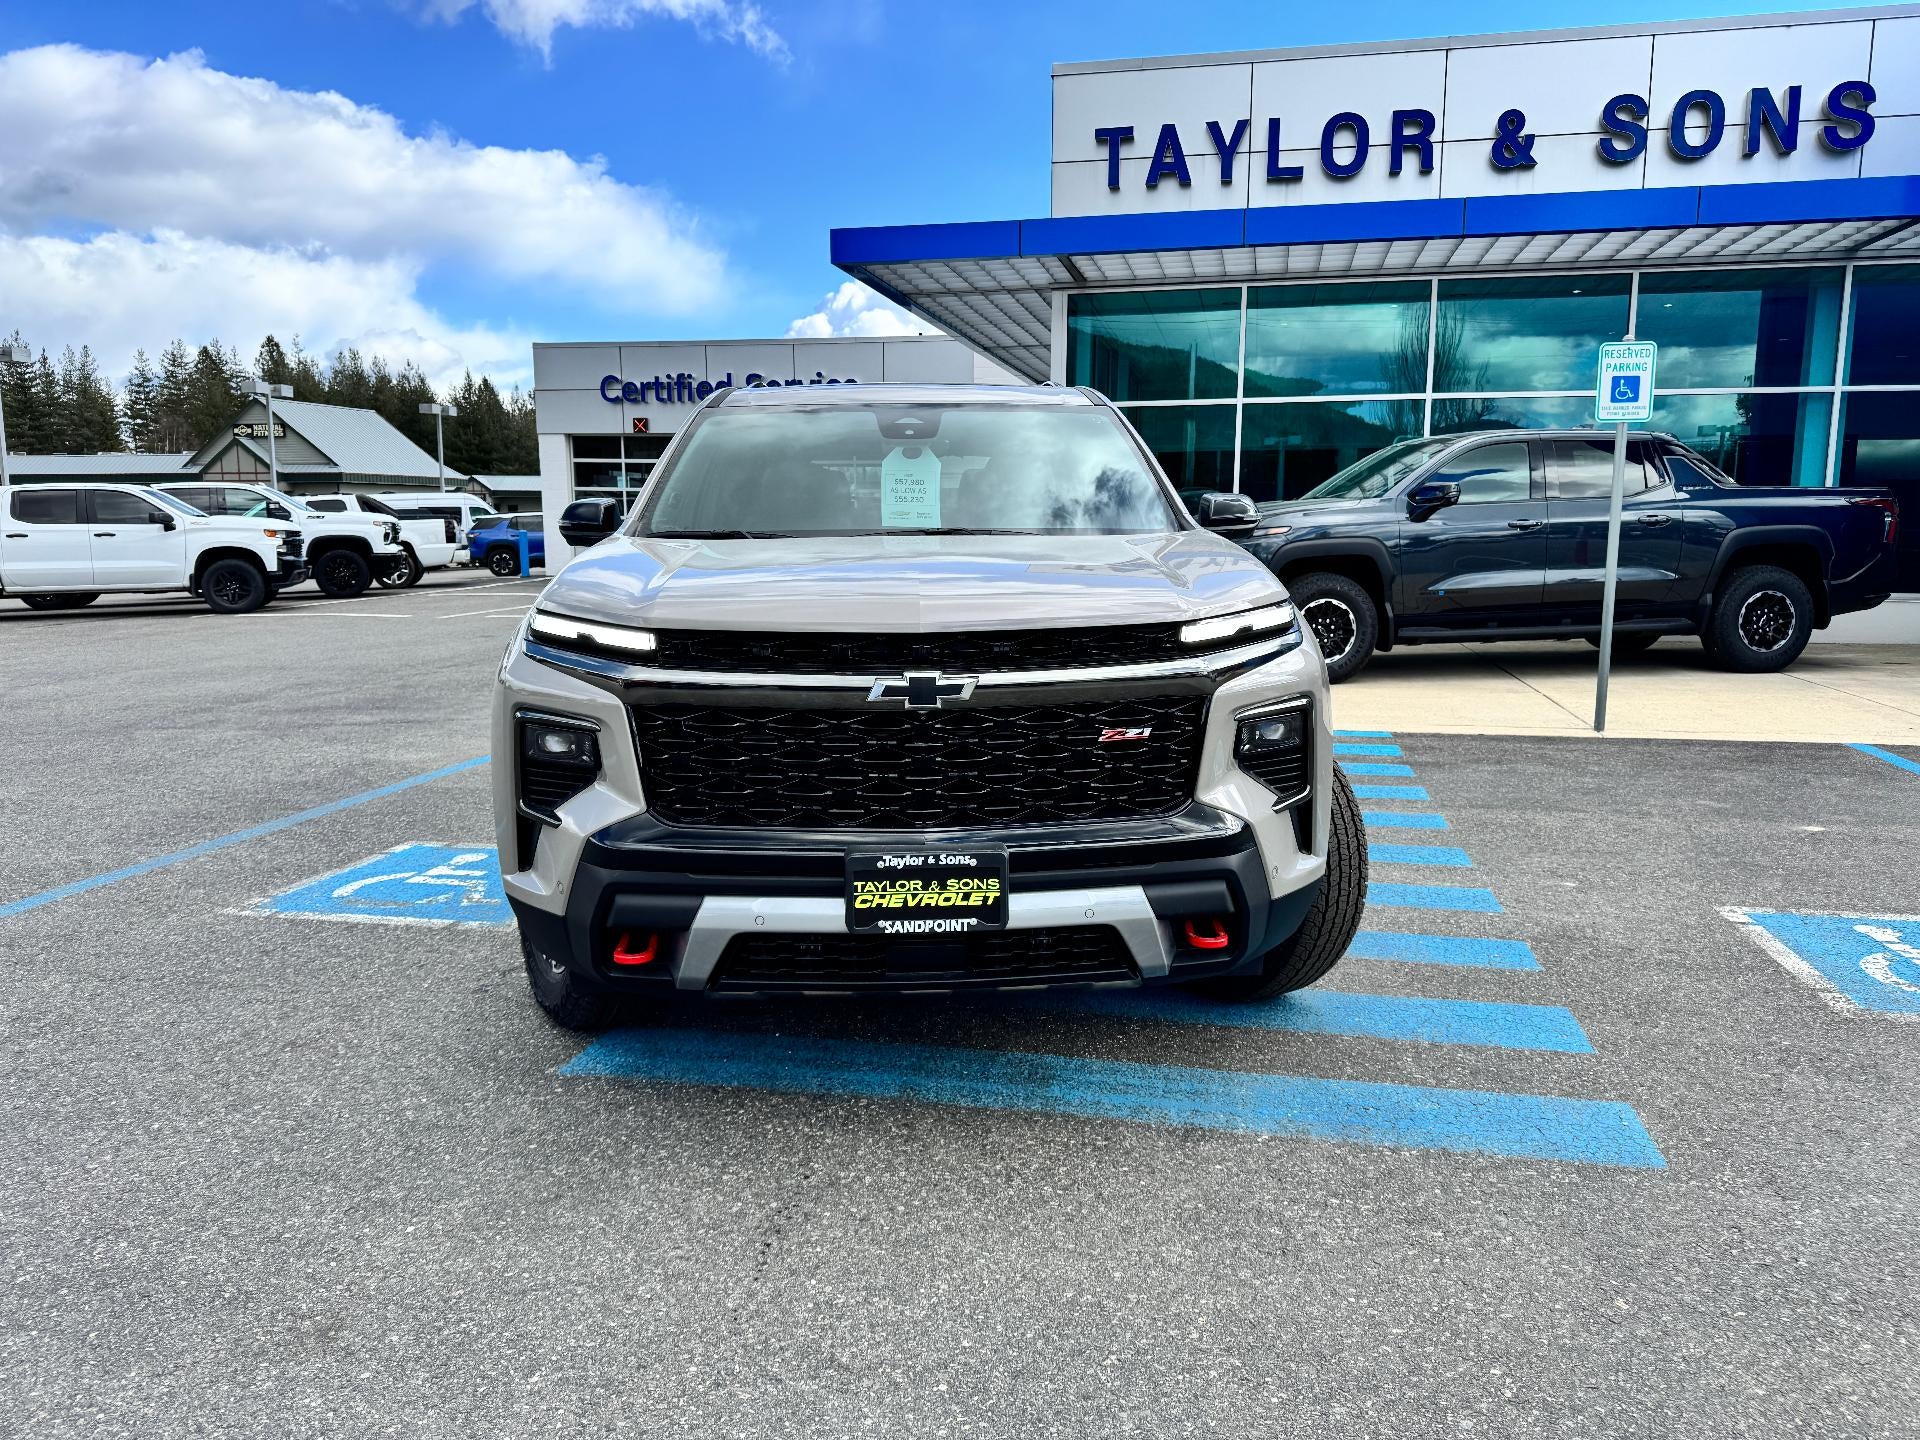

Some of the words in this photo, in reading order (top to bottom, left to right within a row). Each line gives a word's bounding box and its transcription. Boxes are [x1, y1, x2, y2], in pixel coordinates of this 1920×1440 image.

[1095, 108, 1435, 189] TAYLOR
[1491, 108, 1537, 169] &
[1599, 81, 1877, 164] SONS
[1604, 348, 1651, 359] RESERVED
[1605, 362, 1648, 372] PARKING
[1098, 727, 1152, 741] Z71
[882, 855, 925, 869] Taylor
[927, 856, 936, 865] &
[938, 853, 971, 866] Sons
[854, 880, 923, 893] TAYLOR
[928, 881, 940, 892] &
[946, 878, 1000, 890] SONS
[854, 892, 1001, 909] CHEVROLET
[884, 919, 970, 933] SANDPOINT
